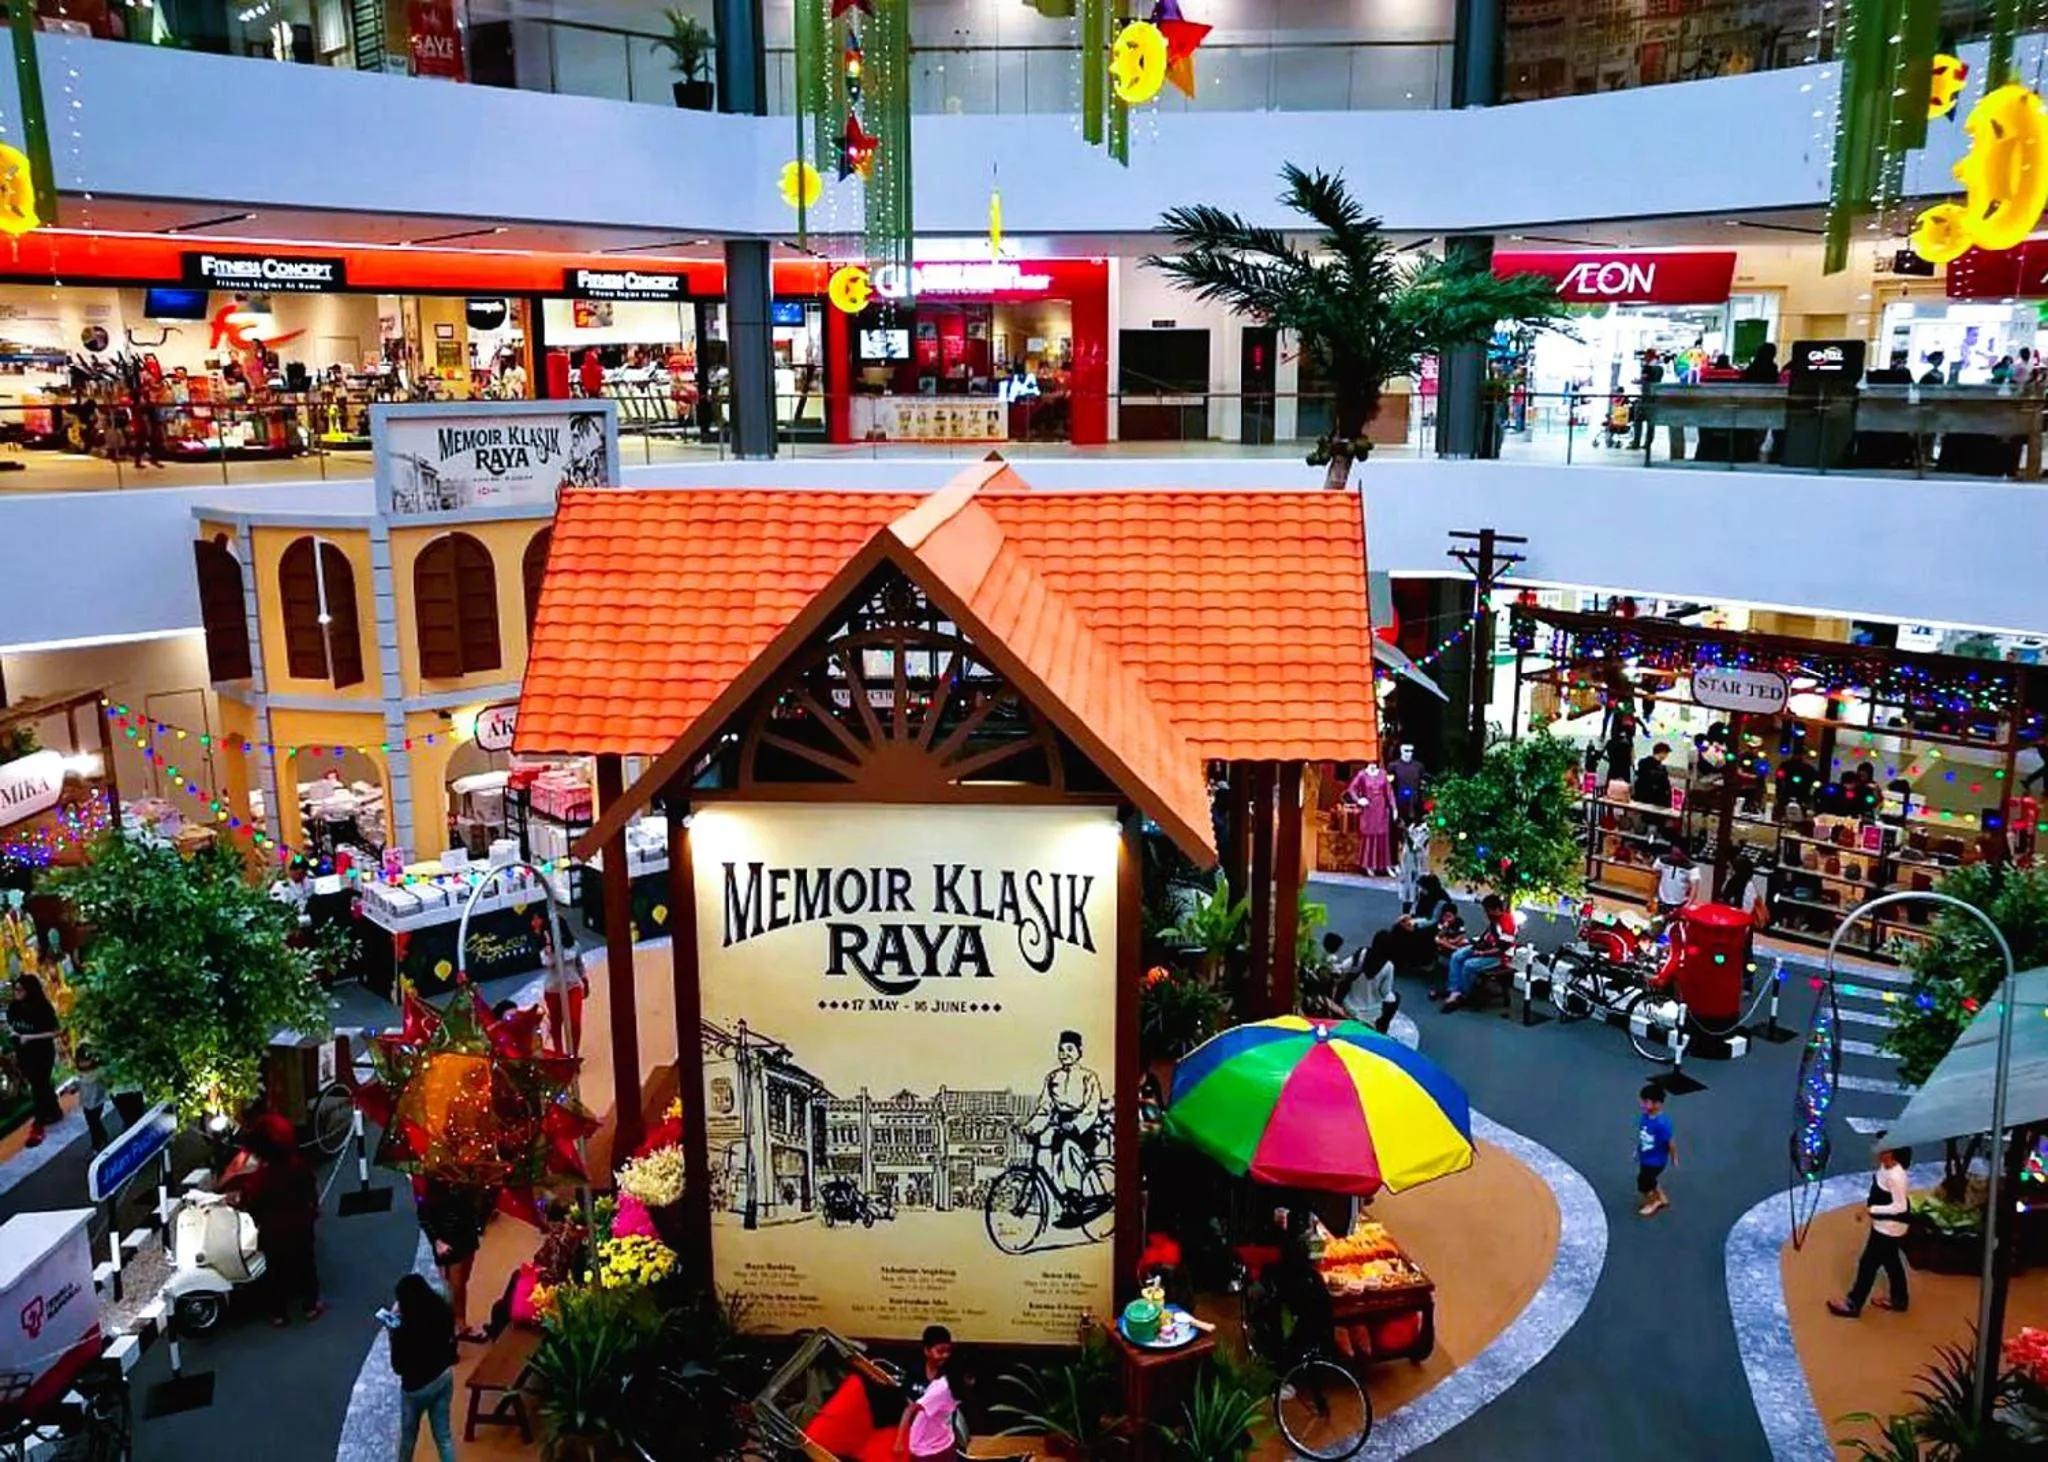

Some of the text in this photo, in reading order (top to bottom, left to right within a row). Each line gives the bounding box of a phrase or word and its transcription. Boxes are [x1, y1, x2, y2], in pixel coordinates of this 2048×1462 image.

[201, 255, 332, 281] FITNESS CONCEPT
[438, 426, 562, 464] MEMOIR KLASIK
[475, 448, 530, 476] RAYA
[721, 862, 1097, 974] MEMOIR KLASIK
[825, 922, 996, 996] RAYA
[852, 999, 864, 1012] 17
[869, 999, 899, 1012] MAY
[931, 1000, 967, 1013] JUNE
